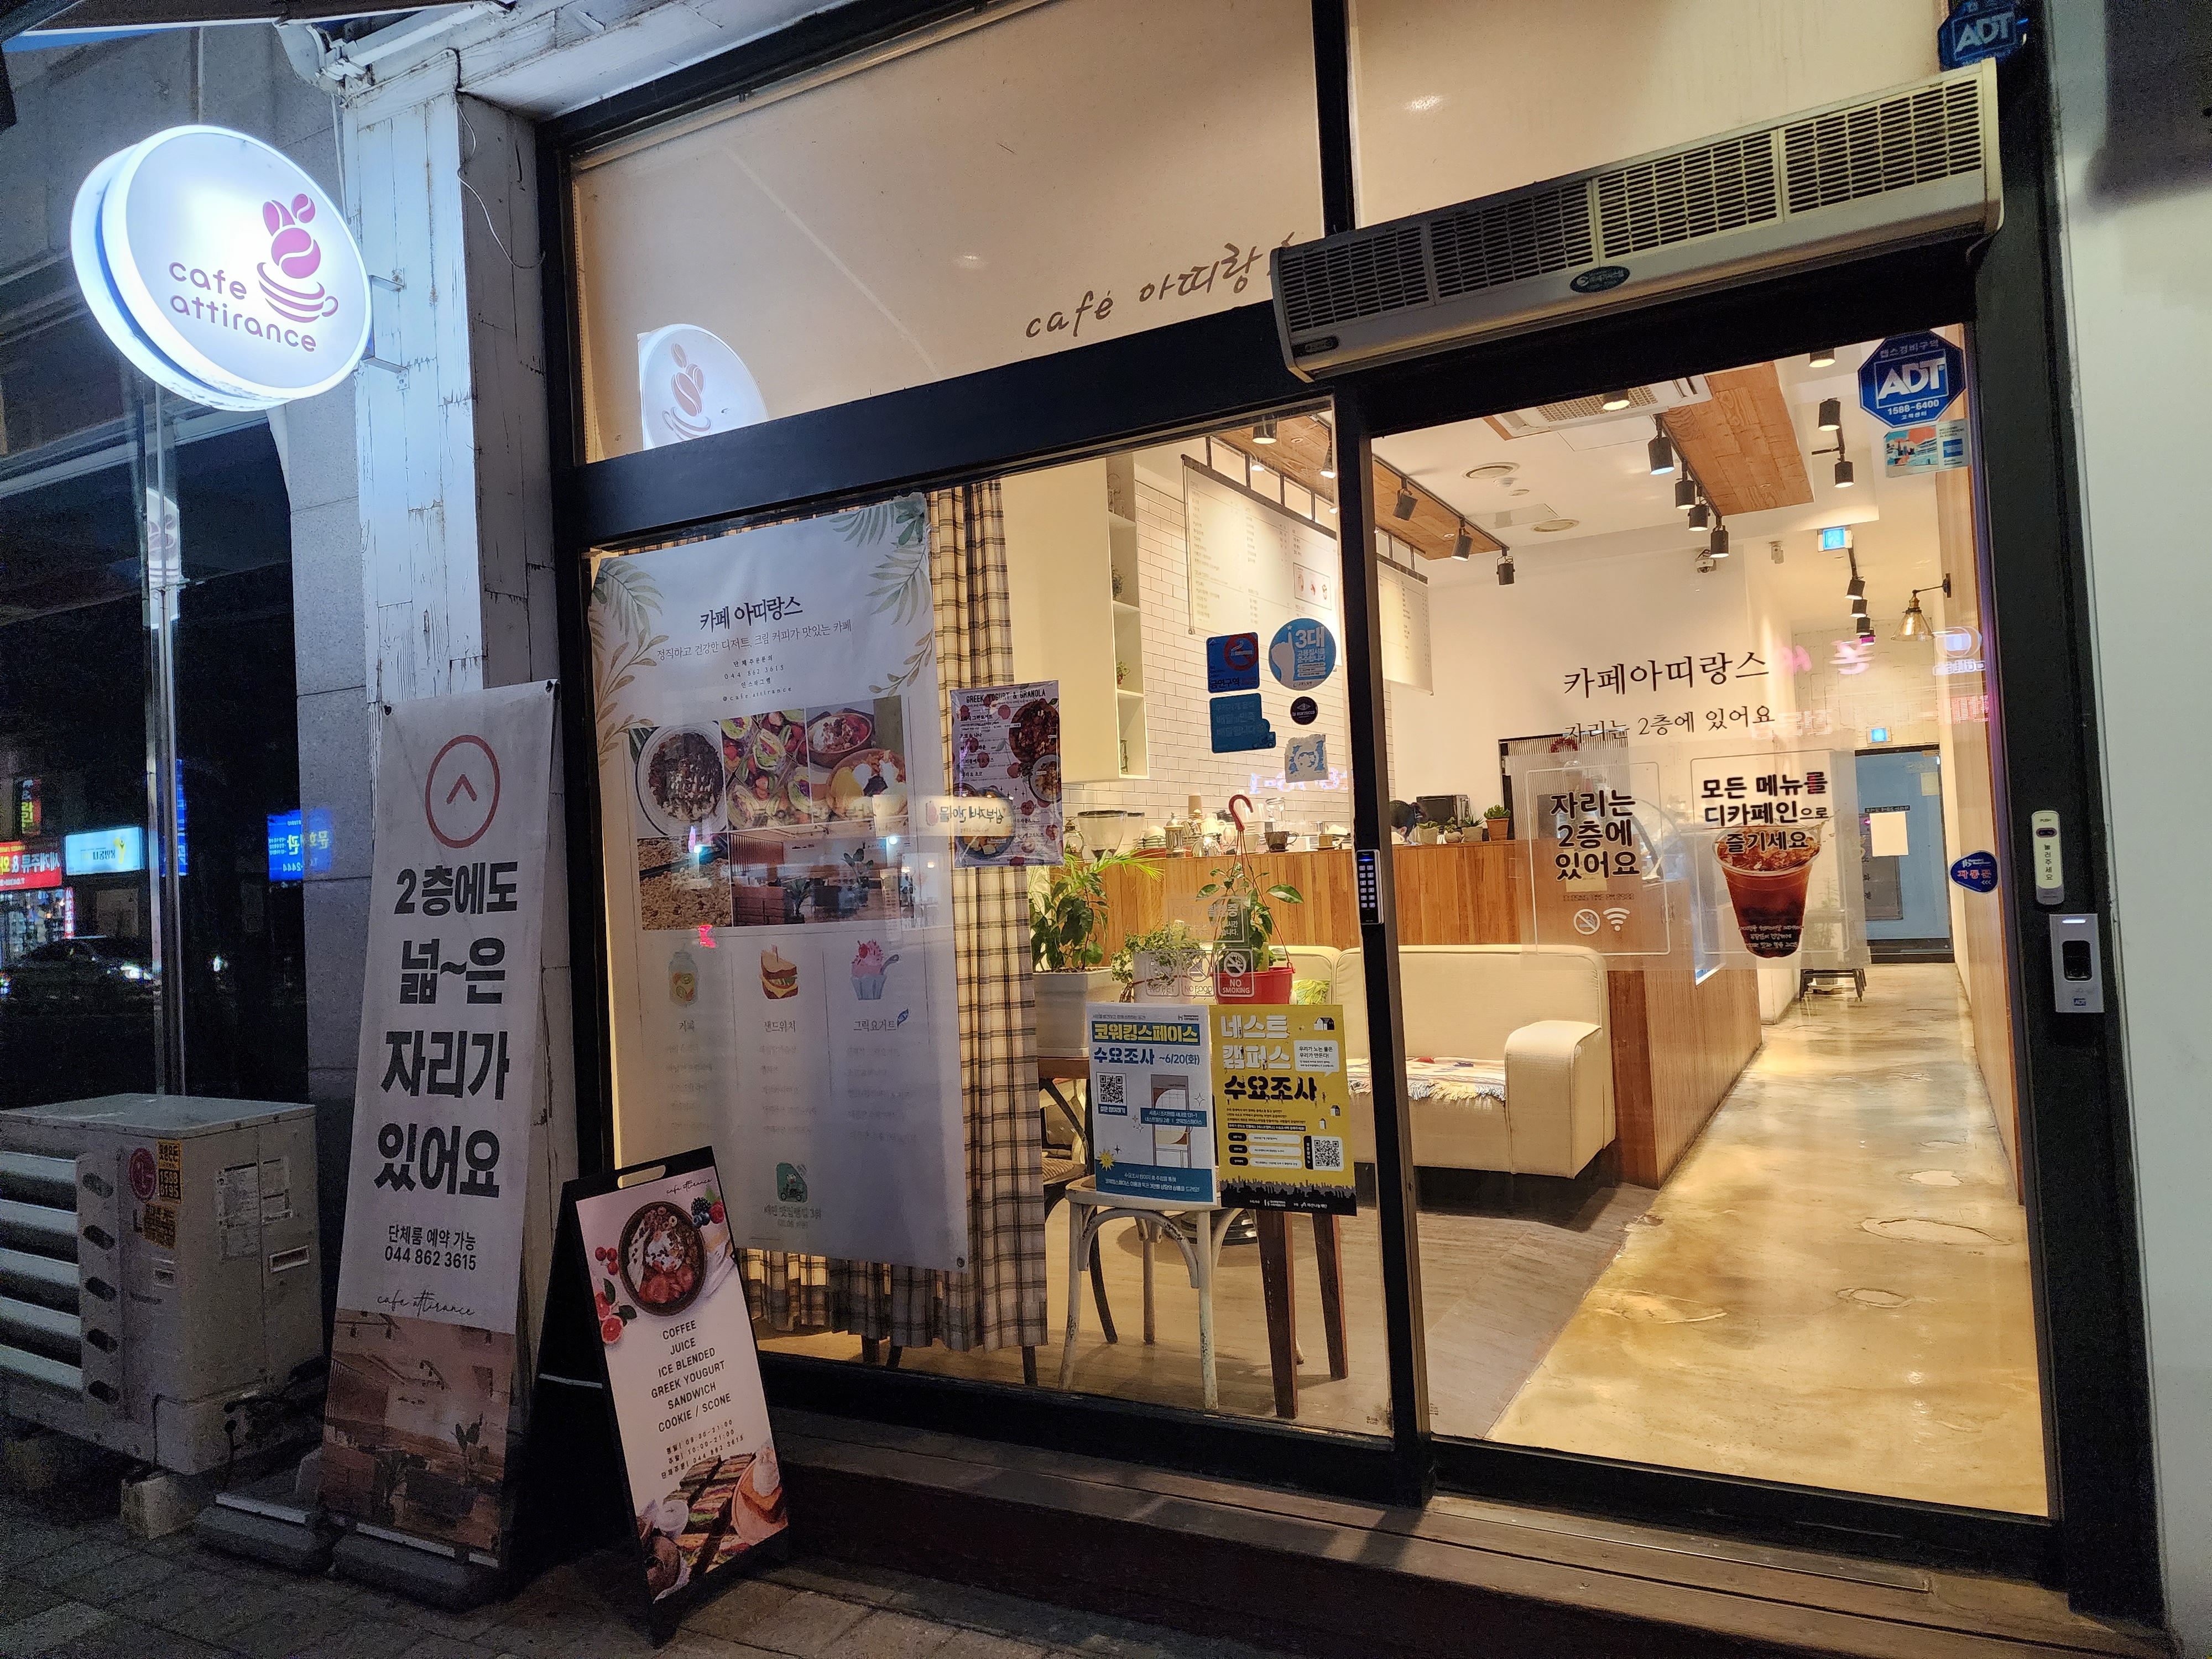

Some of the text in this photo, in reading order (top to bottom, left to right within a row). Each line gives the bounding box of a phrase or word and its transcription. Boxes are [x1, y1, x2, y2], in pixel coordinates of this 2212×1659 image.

[1955, 13, 2015, 53] ADT
[169, 262, 247, 300] cafe
[1026, 231, 1295, 337] café 아띠랑
[169, 295, 316, 352] attirance
[1878, 357, 1945, 399] ADT
[1887, 399, 1939, 415] 1588-6400
[700, 596, 803, 633] 카페 아띠랑스
[657, 647, 692, 661] 정직하고
[694, 640, 719, 656] 건강한
[754, 633, 769, 646] 크림
[772, 627, 800, 643] 커피가
[802, 623, 831, 639] 맛있는
[833, 619, 852, 633] 카페
[1295, 627, 1324, 648] 3대
[724, 665, 784, 680] 044 862 3615
[1210, 677, 1240, 689] 금연구역
[1564, 651, 1770, 698] 카페아띠랑스
[966, 694, 984, 703] GREEK
[987, 692, 1010, 701] YOGURT
[1020, 689, 1046, 698] GRANOLA
[1564, 720, 1631, 743] 자리는
[1638, 711, 1695, 736] 2층에
[1705, 706, 1775, 731] 있어요
[1701, 771, 1829, 799] 모든 메뉴를
[1549, 788, 1636, 820] 자리는
[1704, 801, 1829, 826] 디카페인으로
[1558, 818, 1634, 849] 2층에
[1725, 831, 1810, 854] 즐기세요
[1554, 850, 1640, 881] 있어요
[1957, 869, 1991, 880] 자동문
[394, 860, 518, 916] 2층에도
[400, 937, 506, 1005] 넓~은
[679, 1020, 695, 1033] 커피
[763, 1020, 796, 1033] 샌드위치
[853, 1020, 897, 1033] 그릭요거트
[1094, 1024, 1198, 1042] 코워킹스페이스
[1220, 1015, 1290, 1039] 네스트
[380, 1031, 510, 1101] 자리가
[1094, 1047, 1200, 1066] 수요조사 ~6/20(화)
[1222, 1045, 1291, 1071] 캠퍼스
[1224, 1076, 1317, 1102] 수요조사
[373, 1123, 500, 1198] 있어요
[666, 1183, 681, 1196] cafe
[389, 1224, 476, 1251] 단체룸 예약 가능
[385, 1245, 477, 1271] 044 862 3615
[377, 1289, 475, 1317] cafe attirance
[662, 1320, 697, 1340] COFFEE
[670, 1337, 696, 1355] JUICE
[658, 1347, 716, 1378] ICE BLENDED
[651, 1360, 725, 1399] GREEK YOUGURT
[667, 1381, 716, 1410] SANDWICH
[658, 1410, 692, 1433] COOKIE
[702, 1392, 732, 1413] SCONE
[693, 1453, 707, 1464] 044
